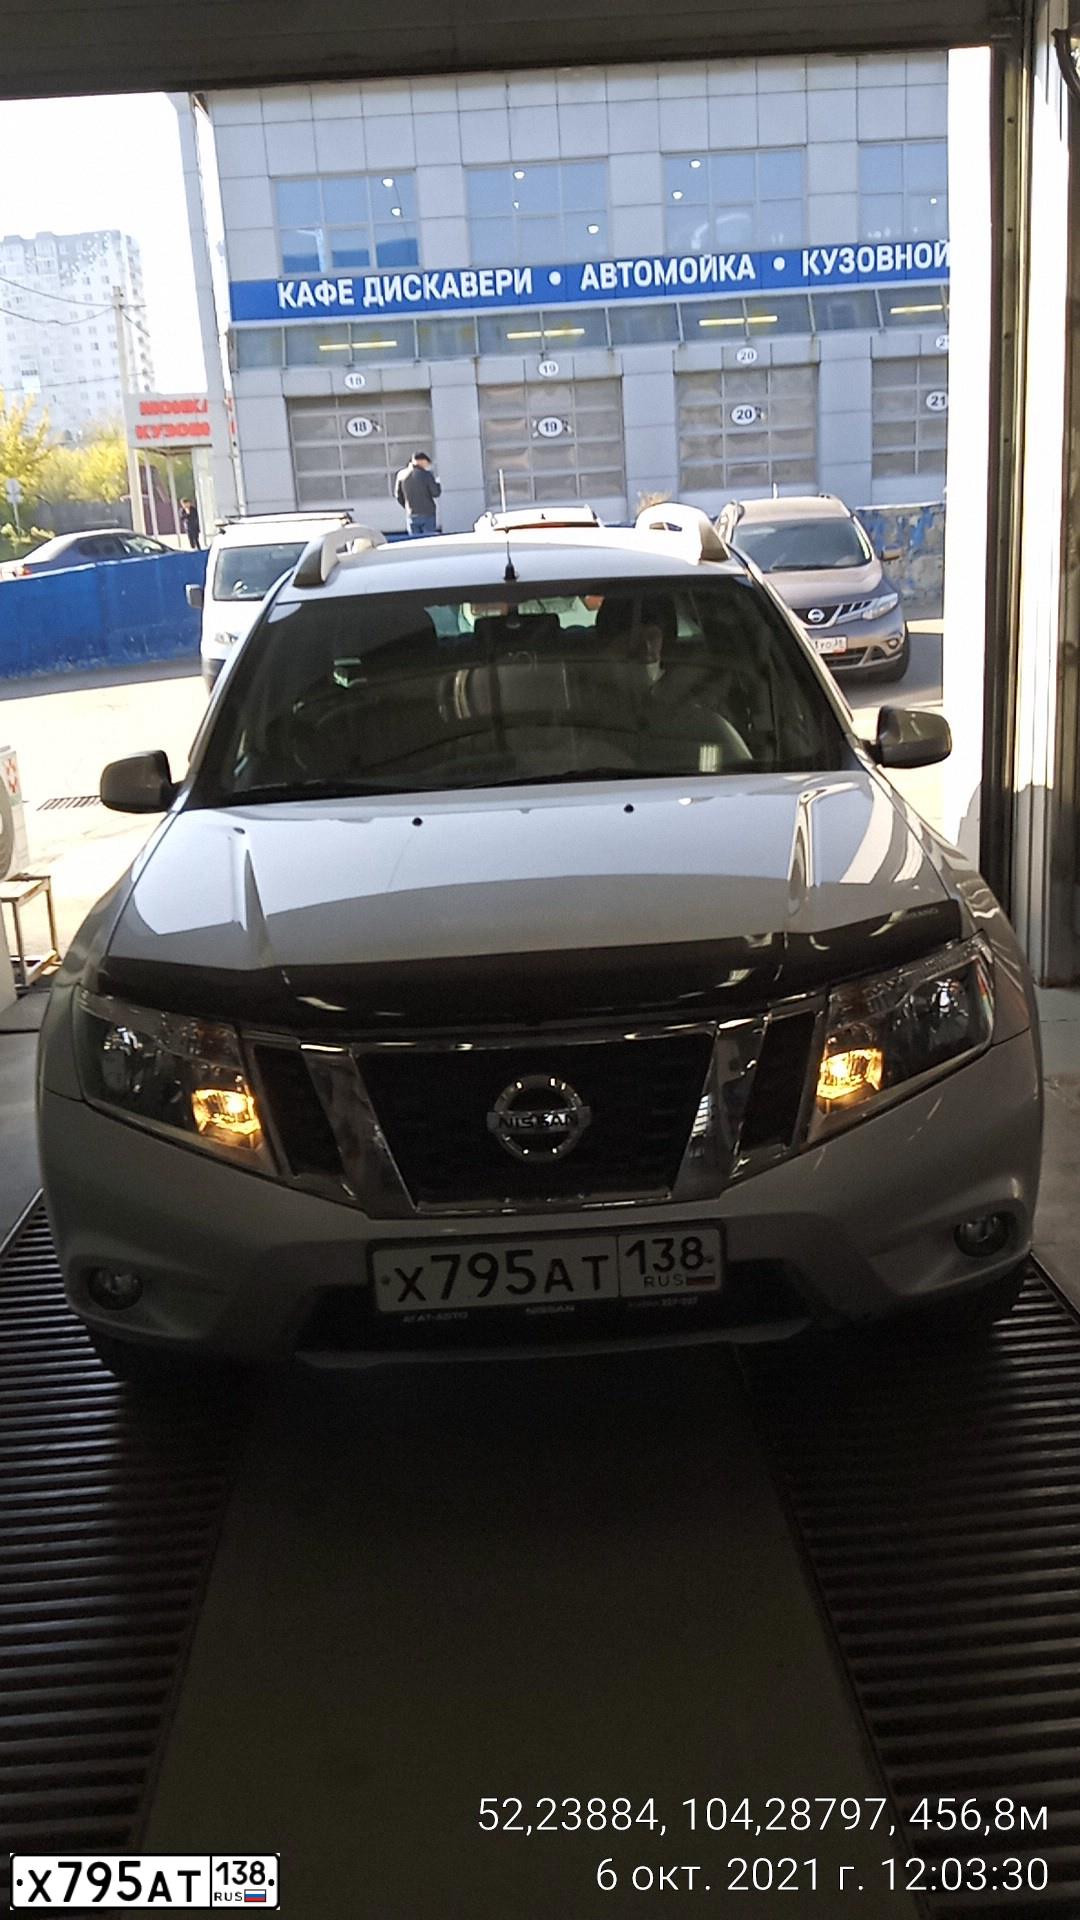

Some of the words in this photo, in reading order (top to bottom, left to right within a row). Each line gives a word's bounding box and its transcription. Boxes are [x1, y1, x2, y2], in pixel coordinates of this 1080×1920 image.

[277, 278, 355, 309] КАФЕ
[363, 267, 533, 307] ДИСКАВЕРИ
[580, 253, 756, 291] АВТОМОЙКА
[802, 240, 949, 276] КУЗОВНОЙ
[740, 351, 754, 361] 20
[931, 394, 946, 407] 21
[736, 409, 753, 420] 20
[353, 421, 367, 433] 18
[545, 422, 557, 432] 19
[499, 1112, 577, 1129] NISSAN
[394, 1250, 609, 1302] Х795АТ
[625, 1236, 704, 1276] 138
[644, 1274, 684, 1289] RUS
